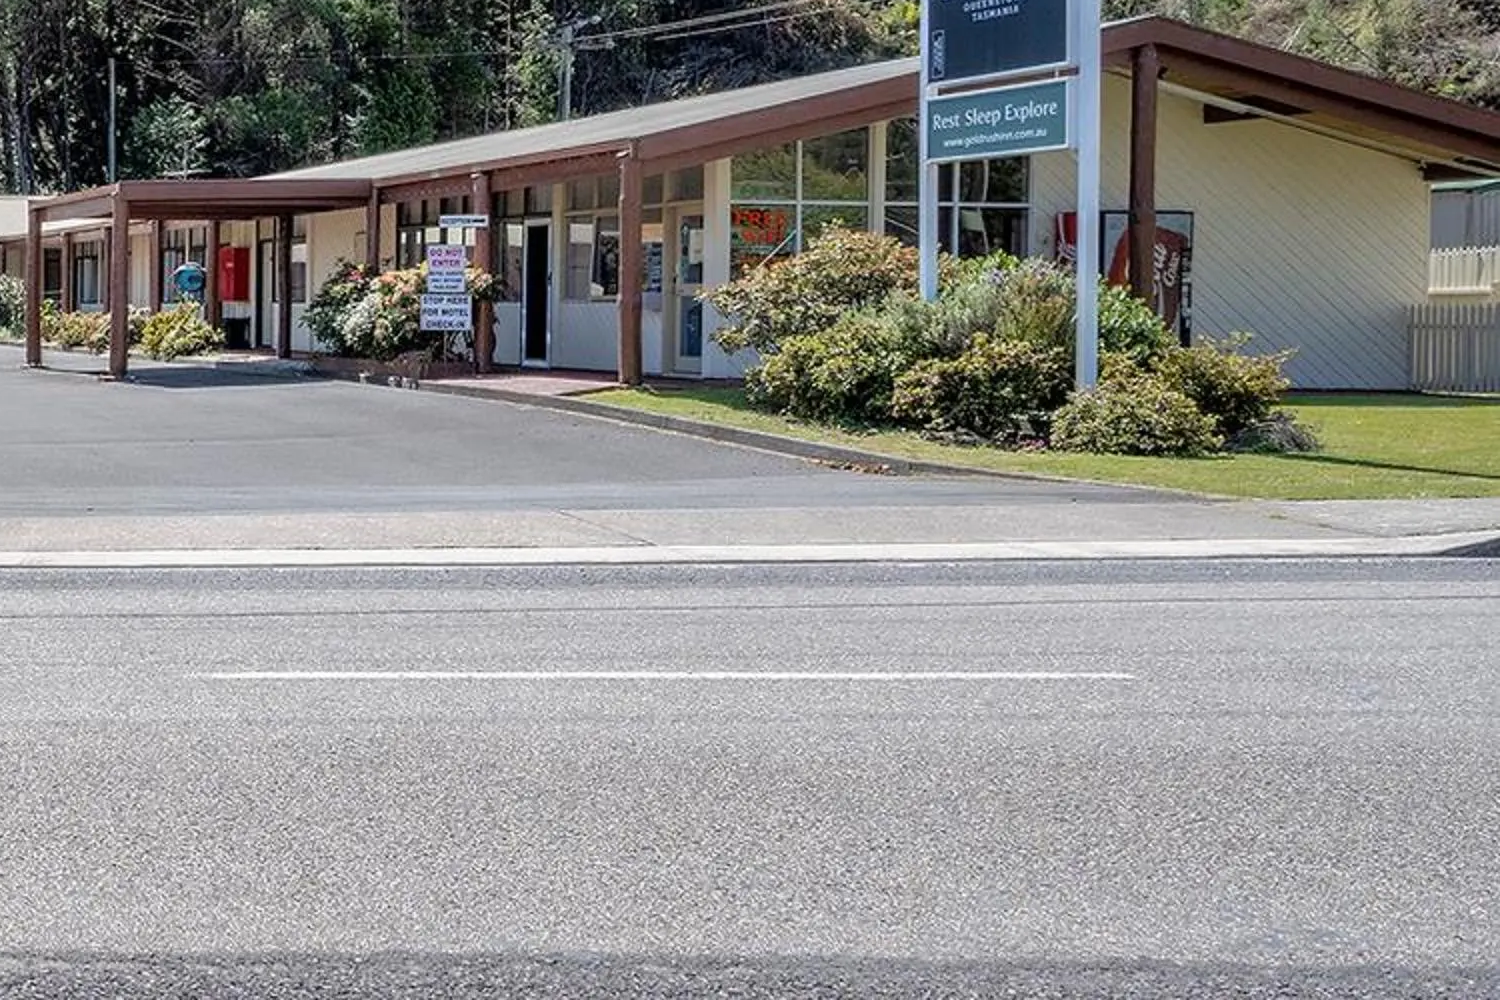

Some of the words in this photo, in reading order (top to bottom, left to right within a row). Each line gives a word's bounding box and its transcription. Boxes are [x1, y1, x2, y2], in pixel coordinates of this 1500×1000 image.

[971, 5, 1019, 22] TASMANIA
[933, 114, 960, 131] Rest
[965, 108, 1001, 127] Sleep
[1004, 100, 1057, 123] Explore
[430, 248, 442, 257] DO
[445, 248, 463, 257] NOT
[431, 259, 461, 267] ENTER
[423, 296, 444, 305] STOP
[447, 297, 469, 305] HERE
[423, 308, 439, 316] FOR
[441, 308, 469, 317] MOTEL
